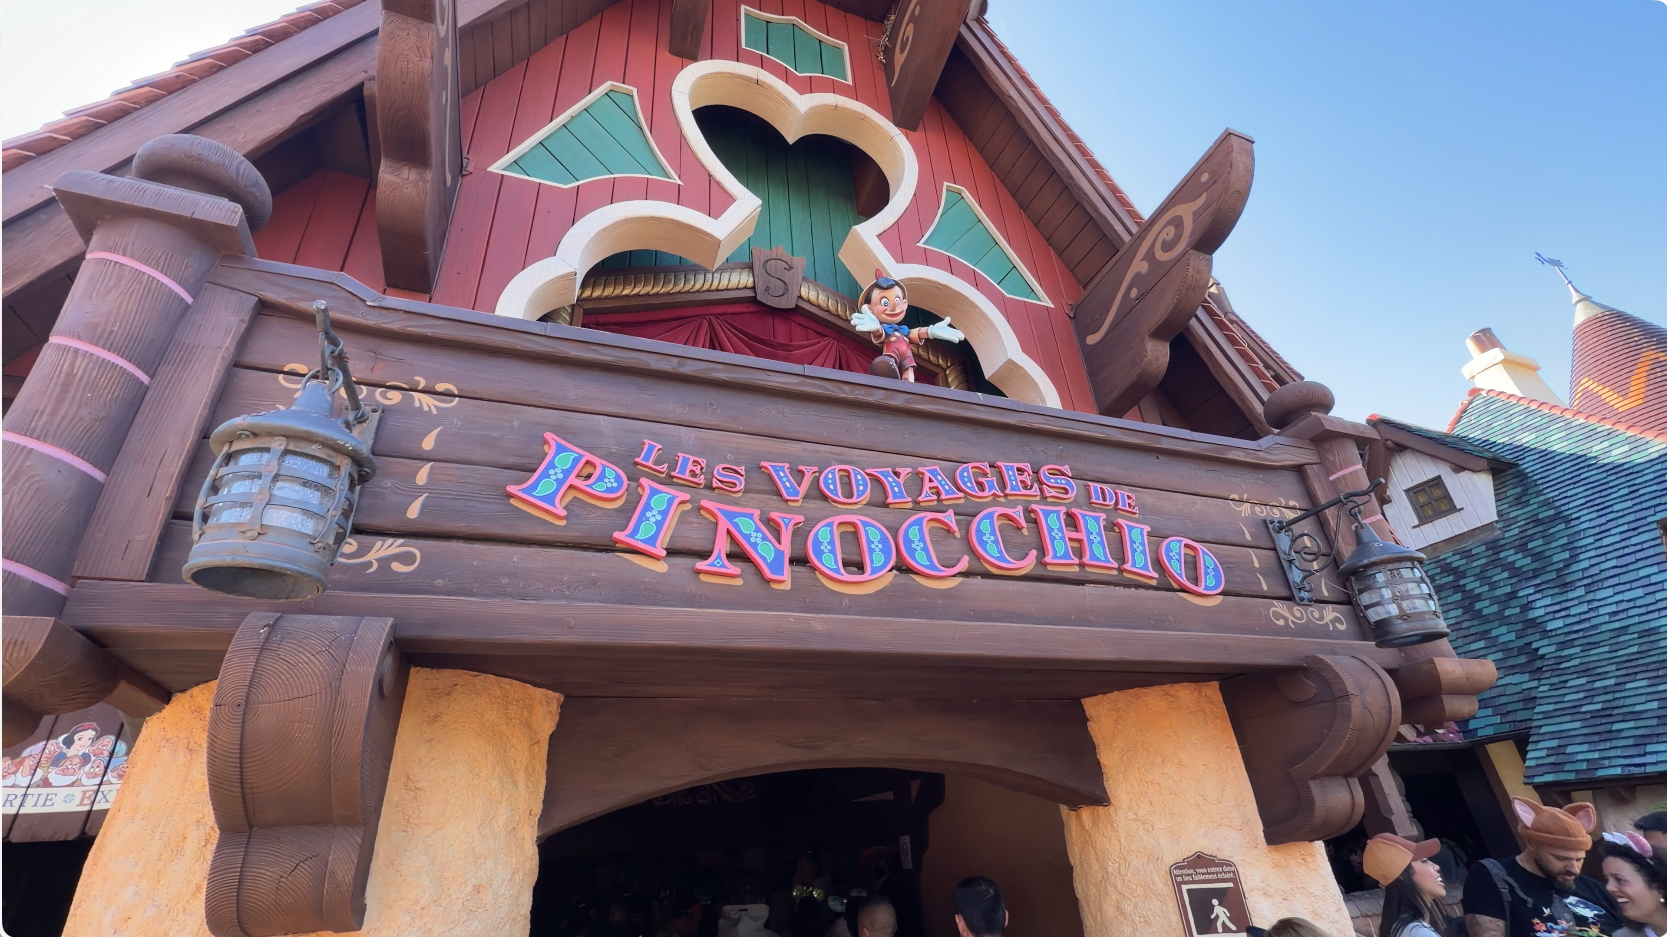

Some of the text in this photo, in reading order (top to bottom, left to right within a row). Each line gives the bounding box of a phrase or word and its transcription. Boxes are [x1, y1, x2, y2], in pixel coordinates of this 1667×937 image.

[762, 257, 794, 298] S
[634, 439, 1139, 515] LES VOYAGES DE
[506, 431, 1225, 596] PINOCCHIO
[76, 789, 120, 807] EX
